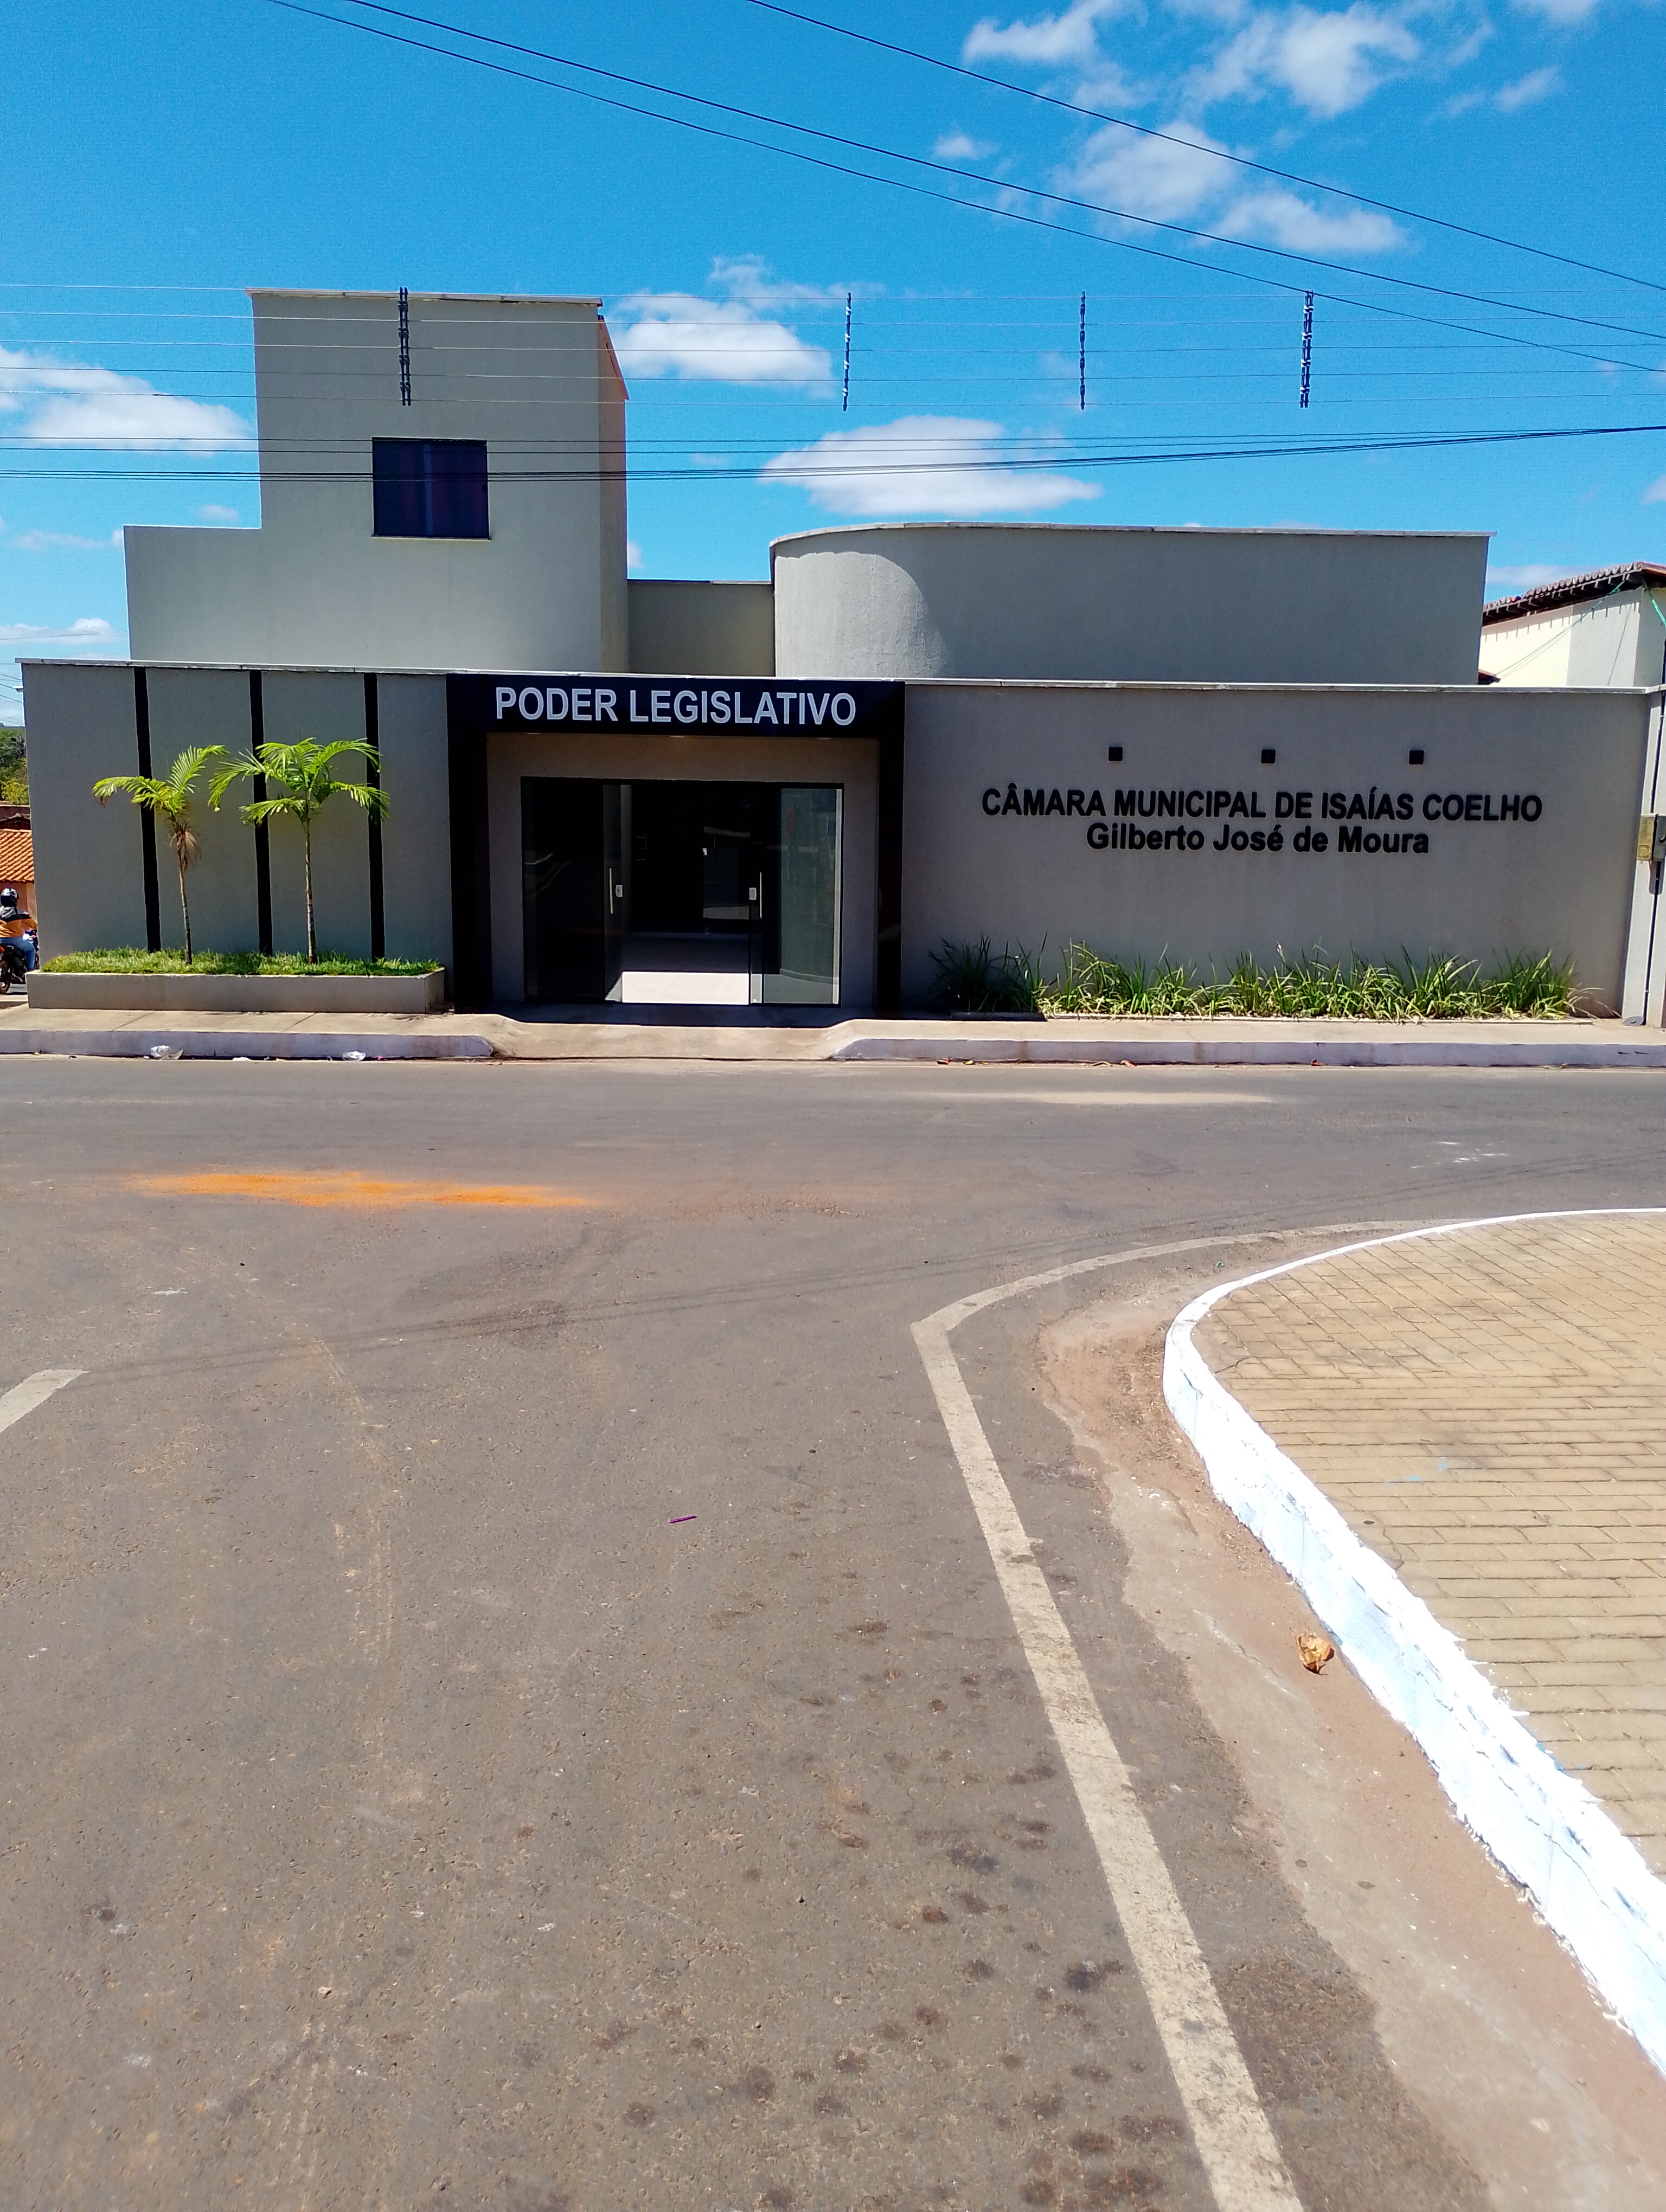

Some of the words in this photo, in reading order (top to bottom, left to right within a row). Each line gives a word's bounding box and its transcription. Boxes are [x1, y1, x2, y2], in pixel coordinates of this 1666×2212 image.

[496, 686, 618, 722] PODER
[630, 690, 856, 726] LEGISLATIVO
[982, 782, 1106, 816] CÂMARA
[1113, 789, 1266, 818] MUNICIPAL
[1274, 790, 1313, 819] DE
[1321, 785, 1414, 821] ISAÍAS
[1422, 793, 1543, 822] COELHO
[1086, 821, 1205, 851] Gilberto
[1213, 824, 1284, 852] José
[1293, 824, 1329, 853] de
[1337, 824, 1430, 854] Moura
